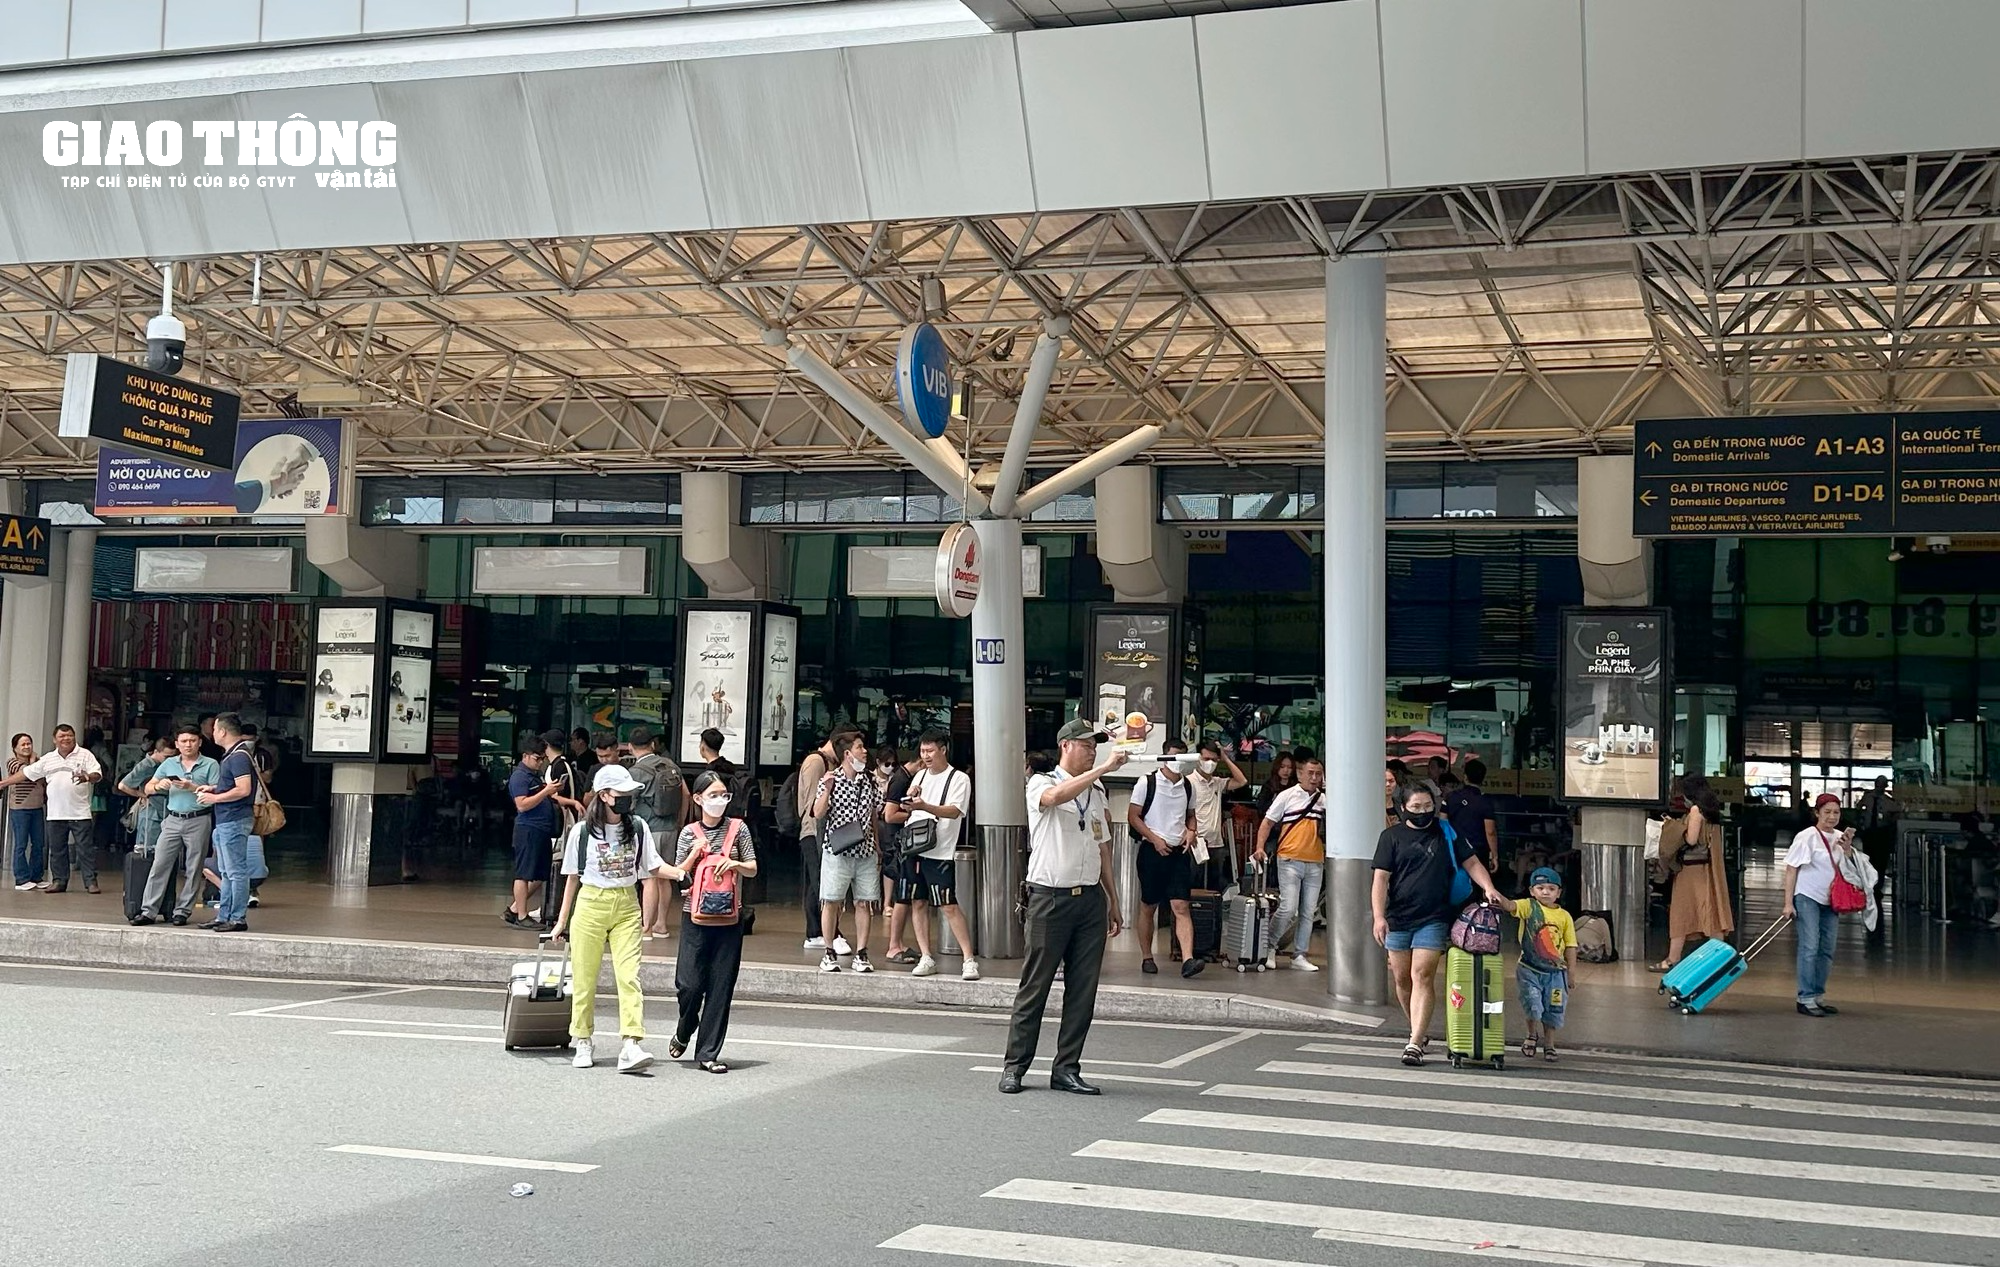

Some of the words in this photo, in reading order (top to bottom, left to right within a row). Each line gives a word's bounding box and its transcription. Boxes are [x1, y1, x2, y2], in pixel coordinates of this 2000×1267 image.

[922, 364, 948, 398] VIB
[126, 374, 148, 390] KHU
[149, 381, 170, 396] VỰC
[200, 395, 213, 408] XE
[121, 391, 157, 411] KHÔNG
[181, 408, 187, 419] 3
[188, 409, 214, 426] PHÚT
[142, 415, 158, 428] Car
[158, 419, 191, 439] Parking
[1901, 431, 1920, 441] GA
[1923, 426, 1961, 441] QUỐC
[1964, 426, 1982, 440] TẾ
[123, 427, 164, 447] Maximum
[164, 438, 171, 448] 3
[172, 439, 204, 457] Minutes
[1673, 440, 1690, 449] GA
[1693, 436, 1720, 449] ĐẾN
[1723, 437, 1766, 448] TRONG
[1770, 434, 1806, 447] NƯỚC
[1815, 437, 1886, 456] A1-A3
[1901, 444, 1975, 455] International
[1672, 451, 1724, 462] Domestic
[1727, 451, 1771, 461] Arrivals
[109, 466, 134, 480] MỜI
[136, 464, 181, 481] QUẢNG
[184, 468, 211, 479] CAO
[1670, 483, 1688, 493] GA
[1691, 483, 1703, 493] ĐI
[1706, 482, 1750, 492] TRONG
[1753, 480, 1789, 492] NƯỚC
[1901, 479, 1920, 489] GA
[1923, 479, 1936, 489] ĐI
[1939, 478, 1985, 489] TRONG
[1989, 478, 2000, 488] N
[1813, 484, 1886, 503] D1-D4
[1901, 493, 1956, 503] Domestic
[1670, 497, 1721, 507] Domestic
[1724, 496, 1786, 508] Departures
[1670, 515, 1707, 523] VIETNAM
[1709, 514, 1750, 523] AIRLINES,
[1751, 514, 1783, 522] VASCO,
[1820, 513, 1862, 522] AIRLINES,
[1756, 522, 1804, 530] VIETRAVEL
[1805, 522, 1846, 530] AIRLINES
[706, 634, 730, 643] Legend
[976, 641, 1004, 662] A-09
[1118, 640, 1147, 651] Legend
[1595, 645, 1630, 657] Legend
[1588, 665, 1612, 673] PHIN
